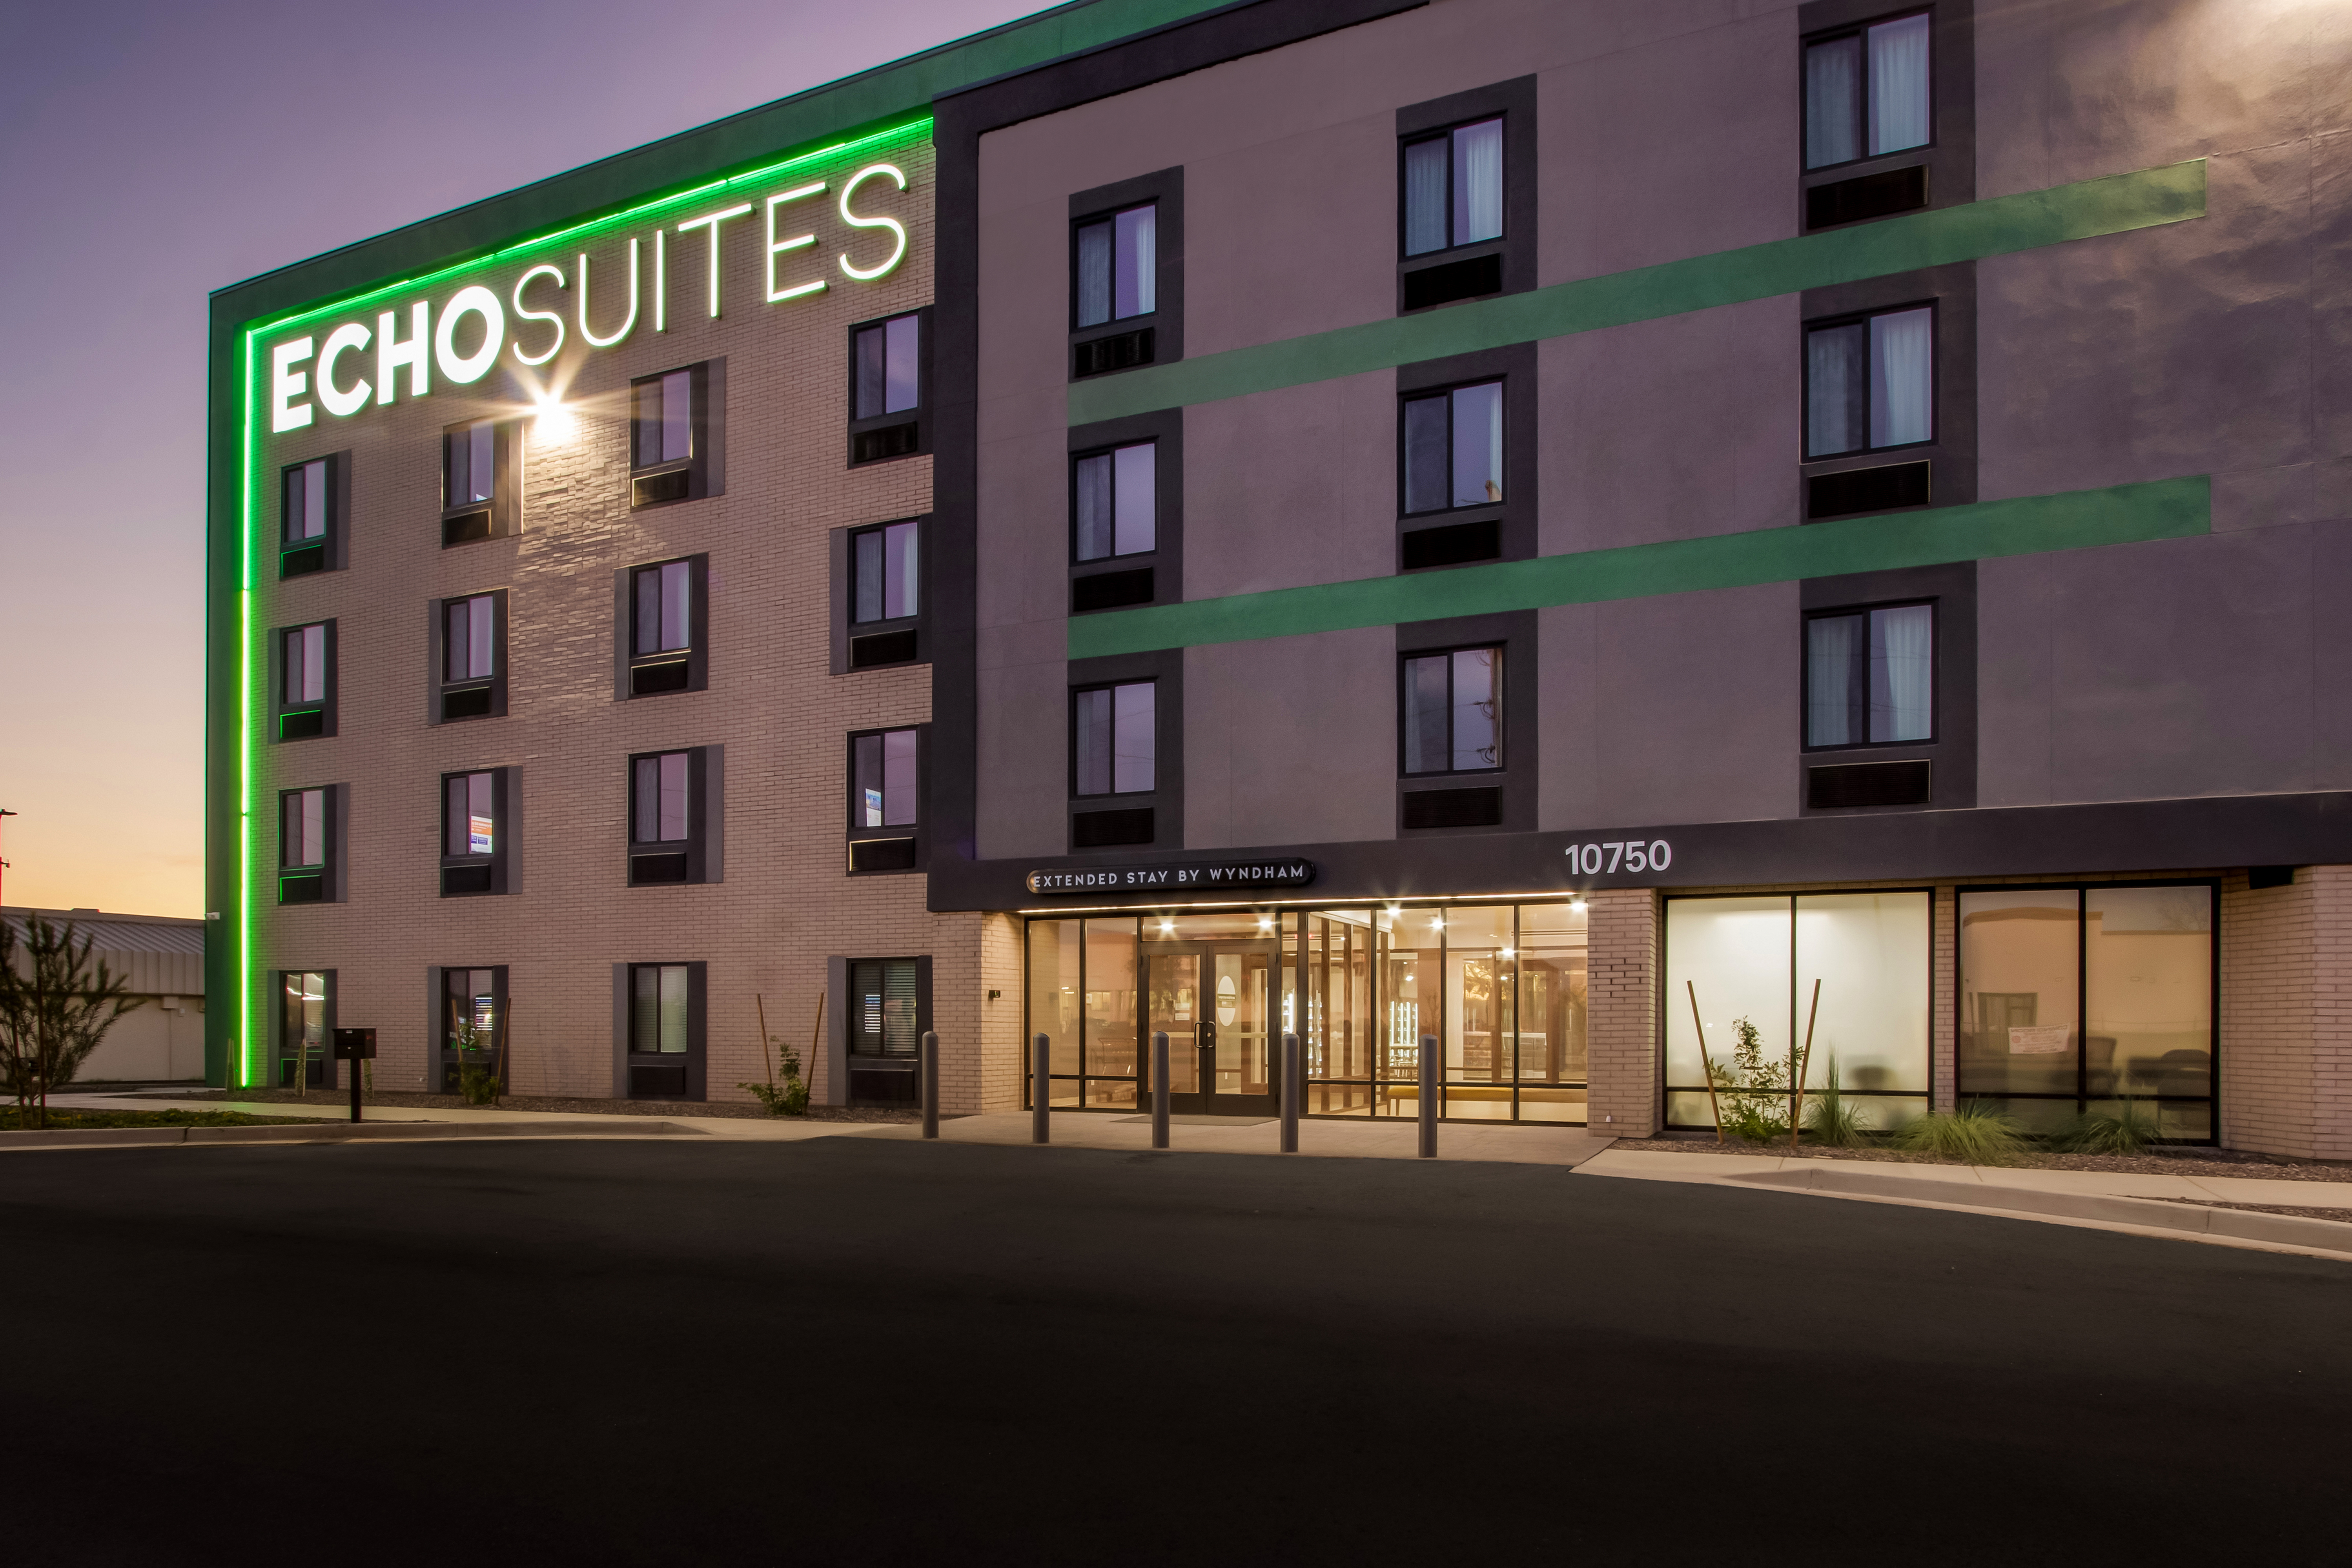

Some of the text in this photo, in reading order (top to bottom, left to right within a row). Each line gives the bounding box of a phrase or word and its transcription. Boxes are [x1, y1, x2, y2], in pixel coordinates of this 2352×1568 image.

[1565, 840, 1671, 875] 10750
[1033, 865, 1303, 887] EXTENDED STAY BY WYNDHAM
